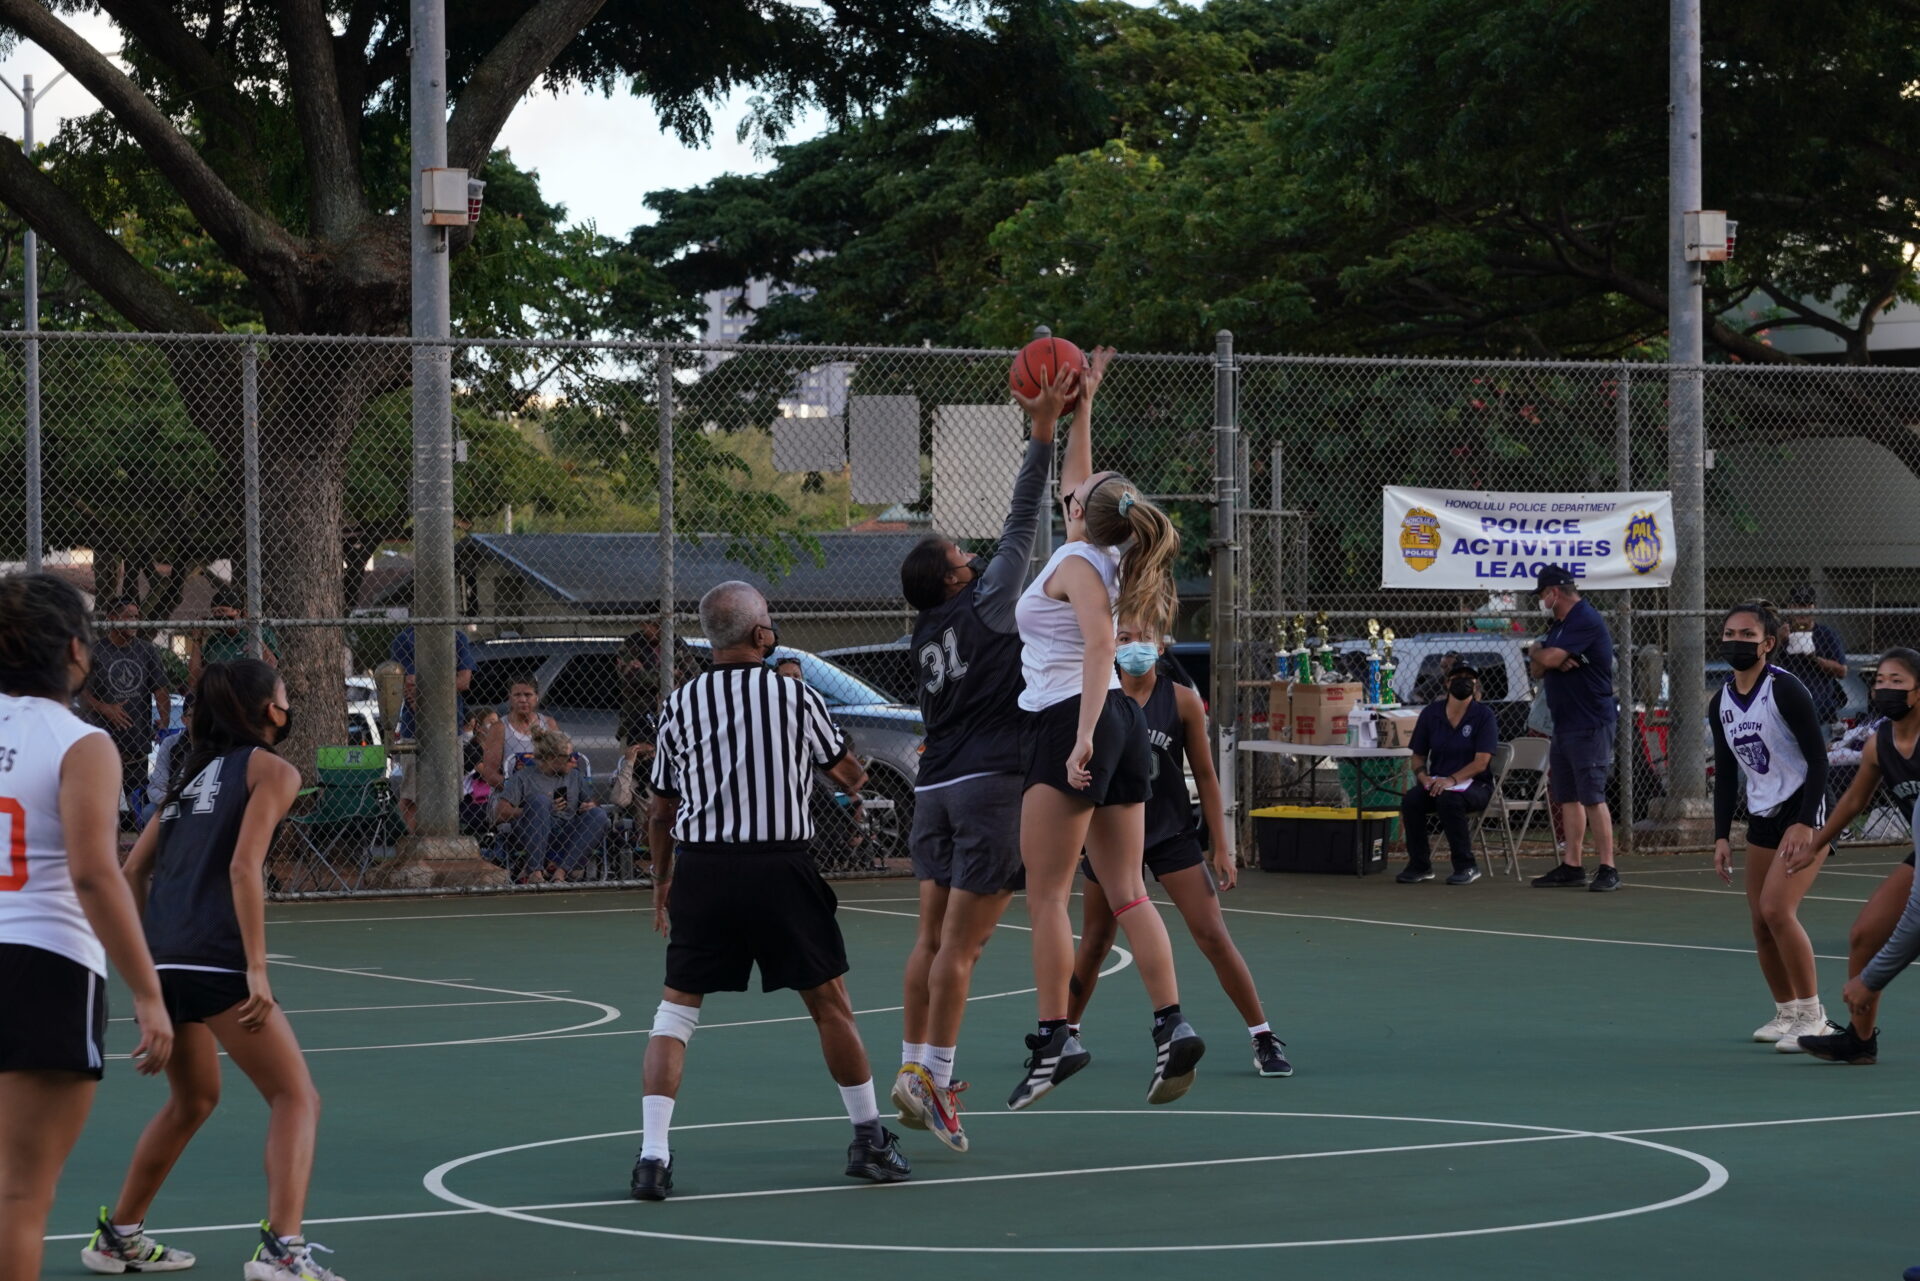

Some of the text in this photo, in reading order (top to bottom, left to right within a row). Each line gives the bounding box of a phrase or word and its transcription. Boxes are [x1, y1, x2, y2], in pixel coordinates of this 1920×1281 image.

[1445, 499, 1617, 512] HONOLULU POLICE DEPARTMENT
[1480, 516, 1581, 534] POLICE
[1632, 522, 1654, 541] PAL
[1405, 549, 1434, 557] POLICE
[1451, 538, 1611, 556] ACTIVITIES
[918, 627, 969, 695] 31
[1738, 721, 1762, 731] SOUTH
[1147, 728, 1173, 751] IDE
